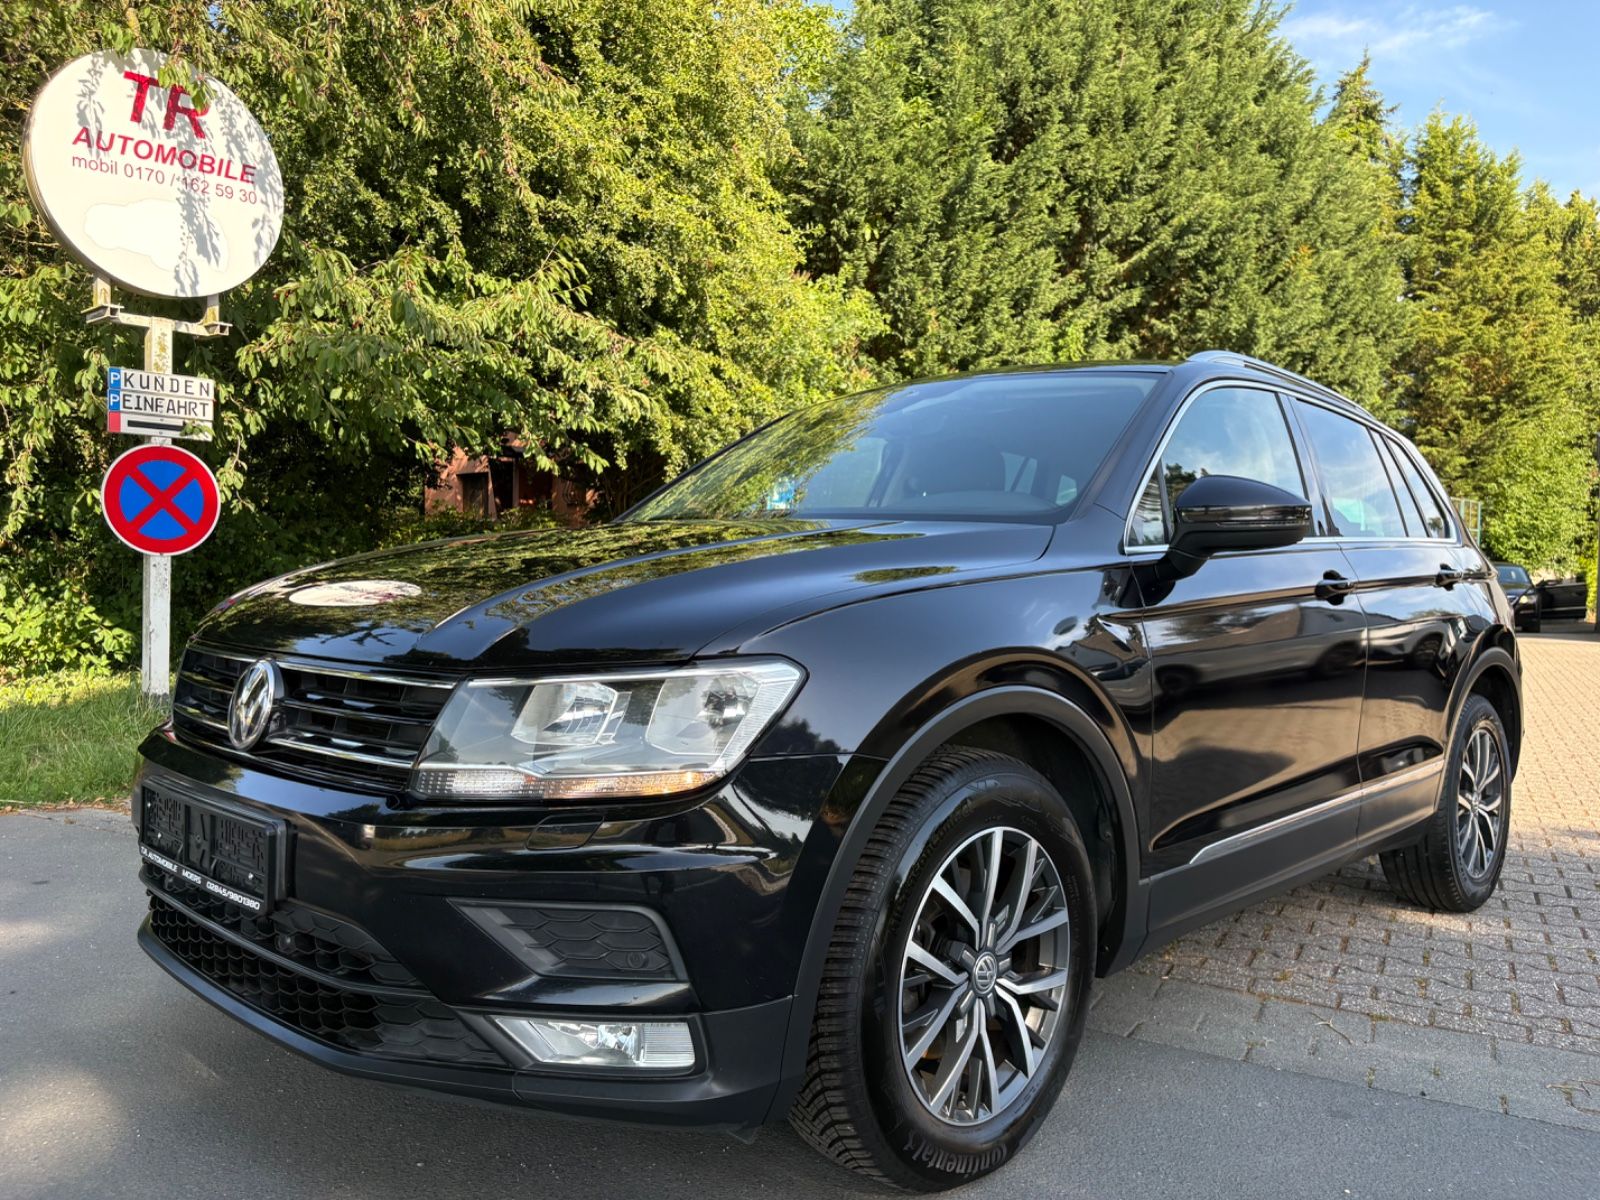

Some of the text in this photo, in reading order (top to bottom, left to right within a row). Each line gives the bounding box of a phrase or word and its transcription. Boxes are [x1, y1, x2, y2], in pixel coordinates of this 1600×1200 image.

[123, 70, 211, 139] TR
[72, 127, 257, 185] AUTOMOBILE
[72, 154, 118, 176] mobil
[124, 163, 166, 185] 0170
[181, 176, 210, 196] 162
[215, 183, 234, 200] 59
[239, 188, 257, 205] 30
[122, 394, 209, 417] EINFAHRT
[123, 372, 210, 397] KUNDEN
[911, 1139, 1008, 1178] Continental
